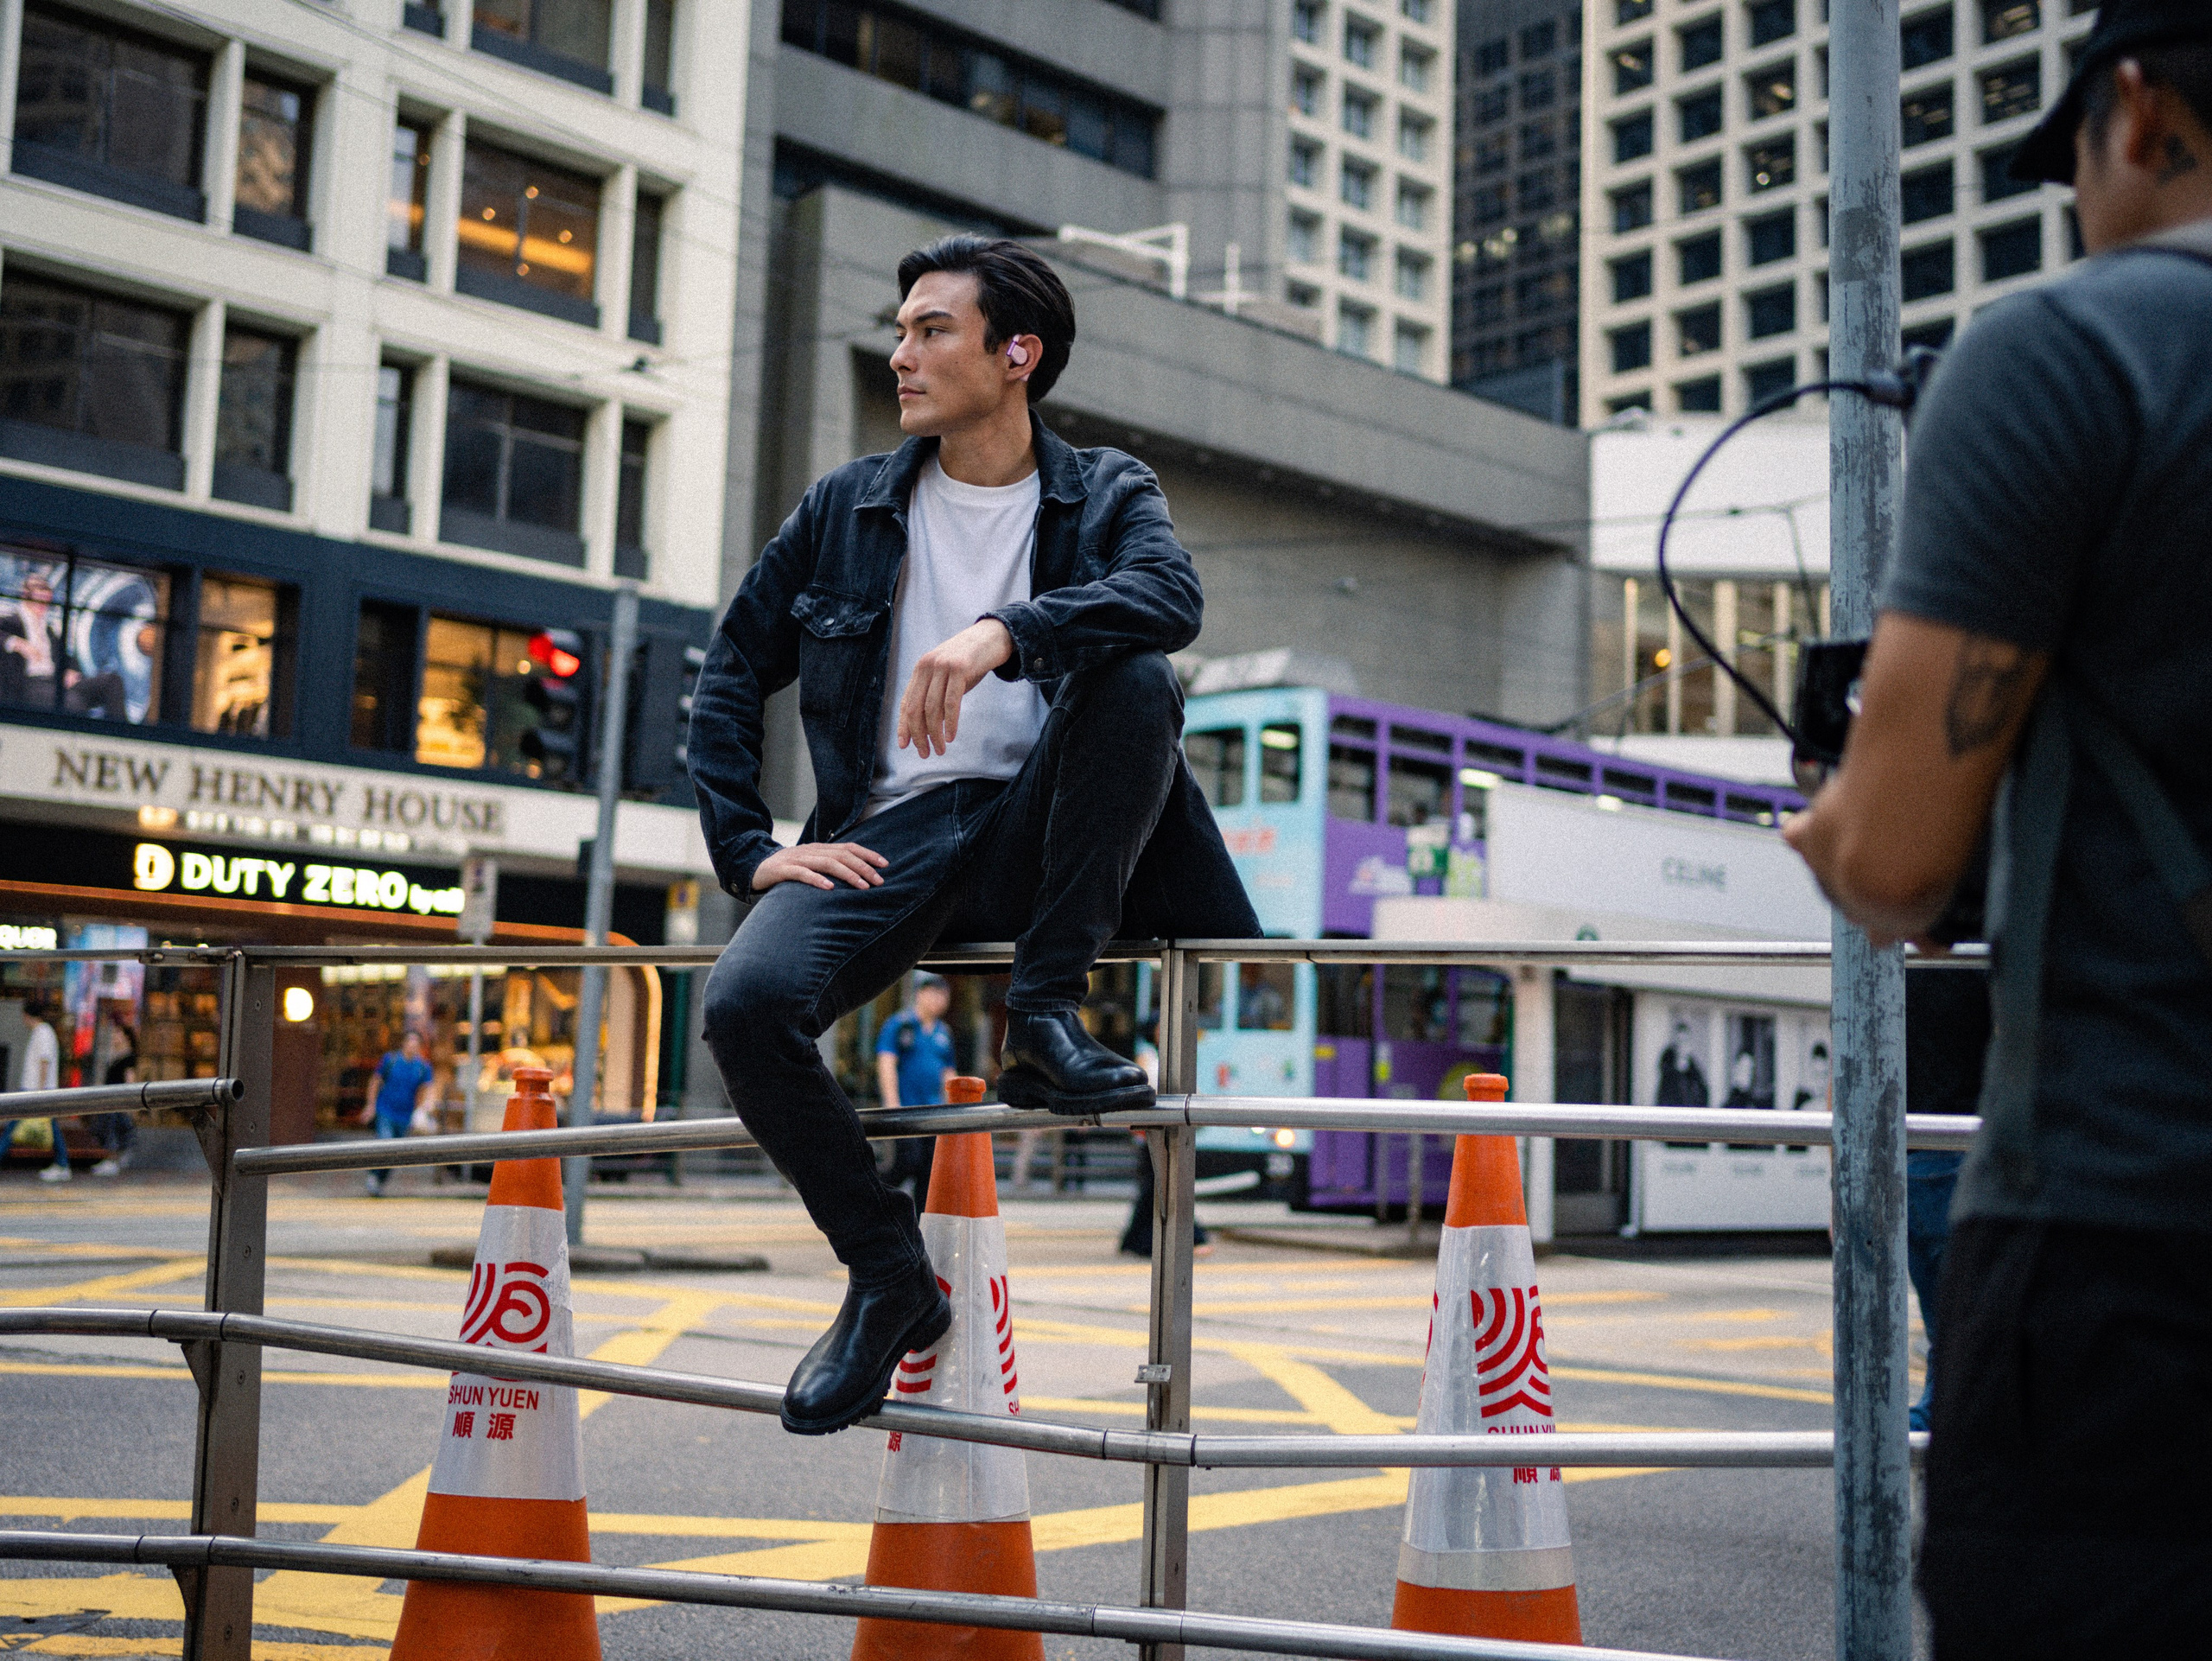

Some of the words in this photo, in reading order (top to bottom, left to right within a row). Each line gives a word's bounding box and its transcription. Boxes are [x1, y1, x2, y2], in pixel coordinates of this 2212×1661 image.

[54, 746, 169, 792] NEW
[188, 764, 342, 815] HENRY
[363, 786, 504, 836] HOUSE
[181, 852, 296, 897] DUTY
[303, 864, 408, 909] ZERO
[448, 1385, 484, 1405] SHUN
[488, 1387, 539, 1410] YUEN
